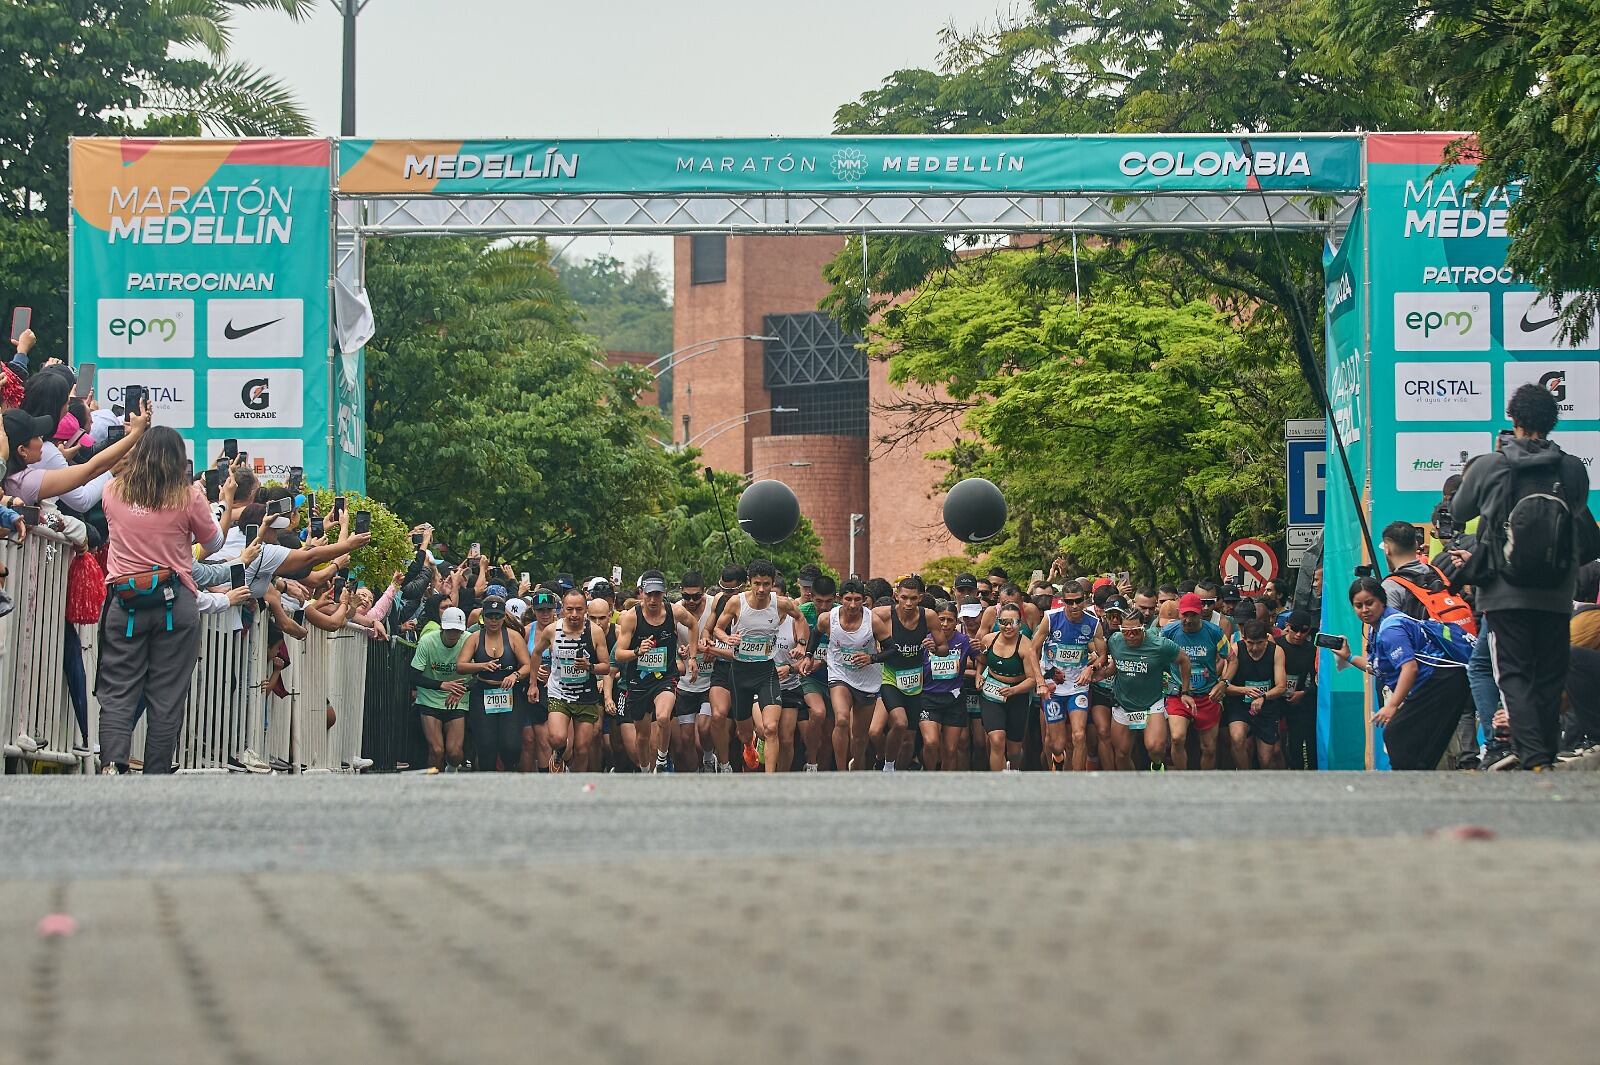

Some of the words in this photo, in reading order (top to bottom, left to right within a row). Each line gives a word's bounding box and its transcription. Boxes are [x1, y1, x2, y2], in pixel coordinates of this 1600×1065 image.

[404, 148, 579, 179] MEDELLÍN
[675, 153, 817, 172] MARATÓN
[882, 153, 1025, 172] MEDELLÍN
[1118, 151, 1311, 177] COLOMBIA
[108, 179, 293, 215] MARATÓN
[108, 208, 293, 244] MEDELLÍN
[127, 273, 275, 291] PATROCINAN
[109, 318, 177, 345] epm
[1405, 311, 1473, 338] epm
[1404, 379, 1480, 397] CRISTAL
[741, 642, 765, 652] 22847
[933, 661, 955, 671] 22203
[486, 695, 508, 705] 21013
